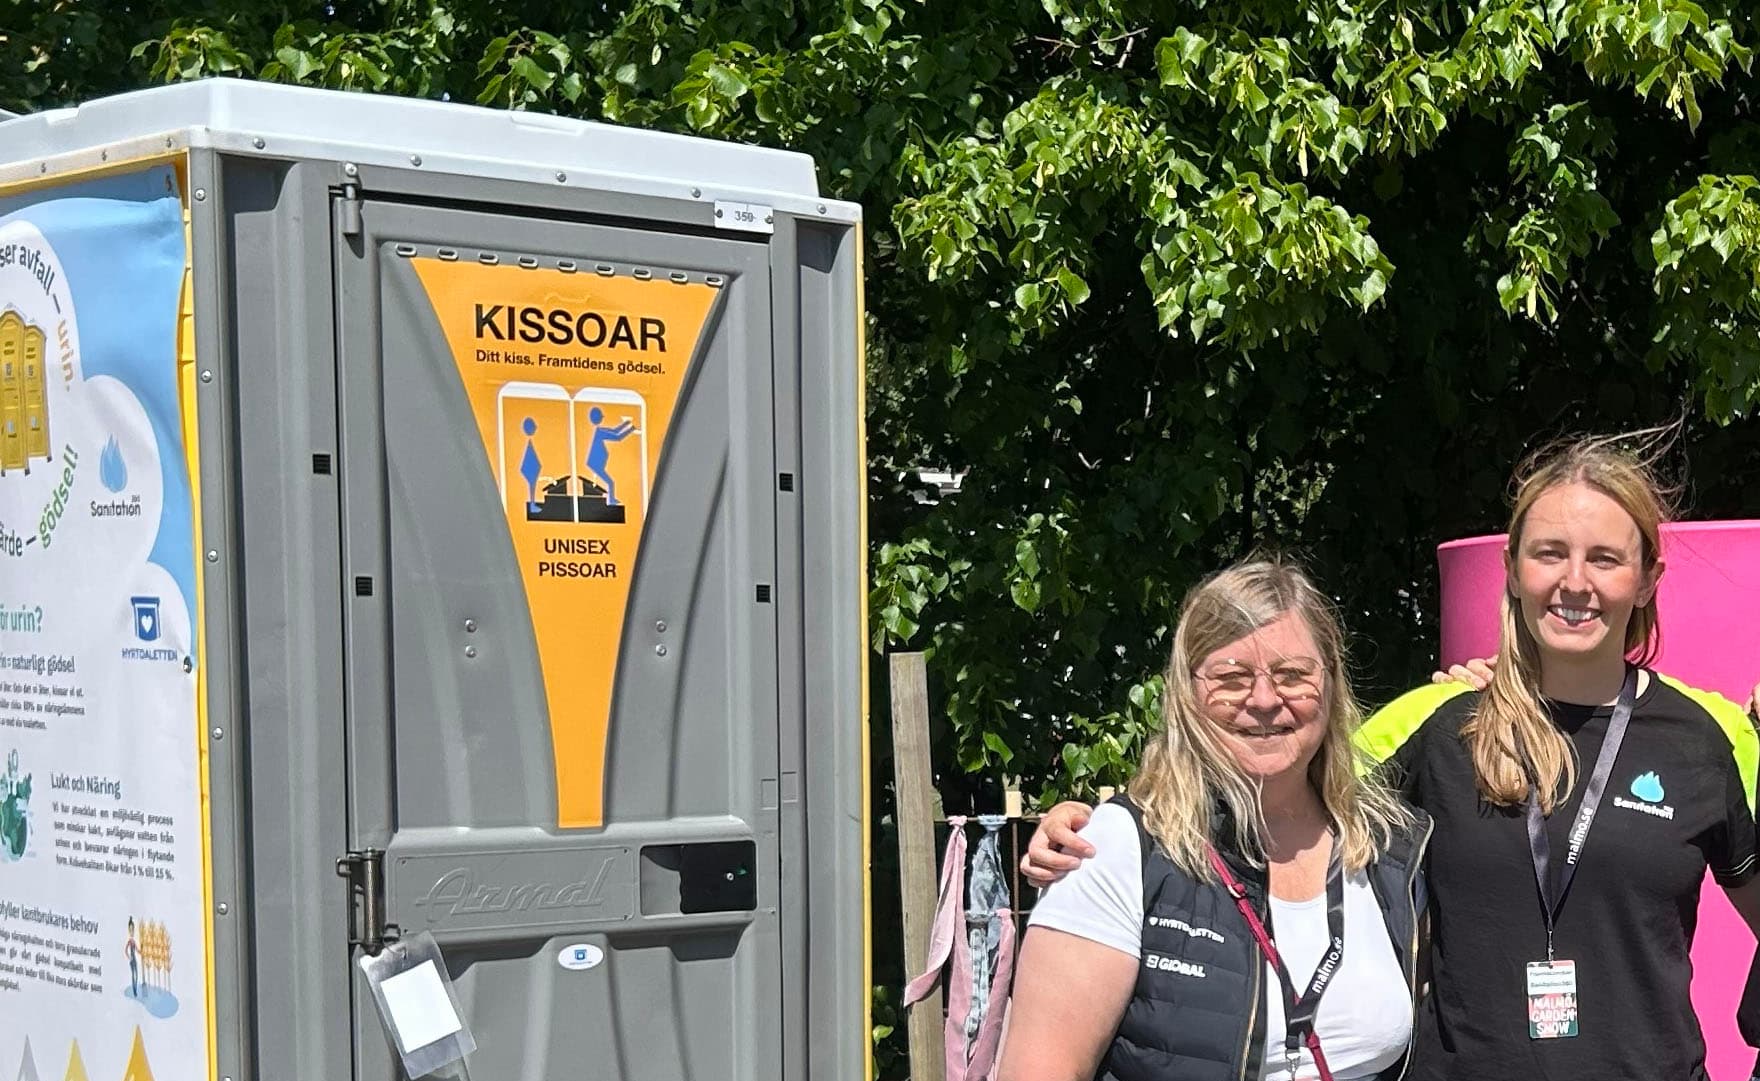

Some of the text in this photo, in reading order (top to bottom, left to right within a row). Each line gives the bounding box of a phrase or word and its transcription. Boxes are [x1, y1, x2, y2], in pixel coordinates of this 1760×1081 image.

[19, 246, 55, 296] avfall
[475, 303, 667, 352] KISSOAR
[476, 350, 666, 375] Ditt kiss. Framtidens gödsel.
[39, 443, 78, 549] gödsel!
[90, 501, 141, 517] Sanitation
[544, 539, 610, 554] UNISEX
[539, 562, 617, 578] PISSOAR
[11, 604, 43, 633] urin?
[50, 771, 121, 800] Lukt och Näring
[1567, 807, 1593, 864] malmo.se
[70, 914, 98, 935] behov
[1158, 957, 1206, 978] GLOBAL
[1532, 1008, 1575, 1022] GARDEN
[1536, 1021, 1570, 1035] SHOW
